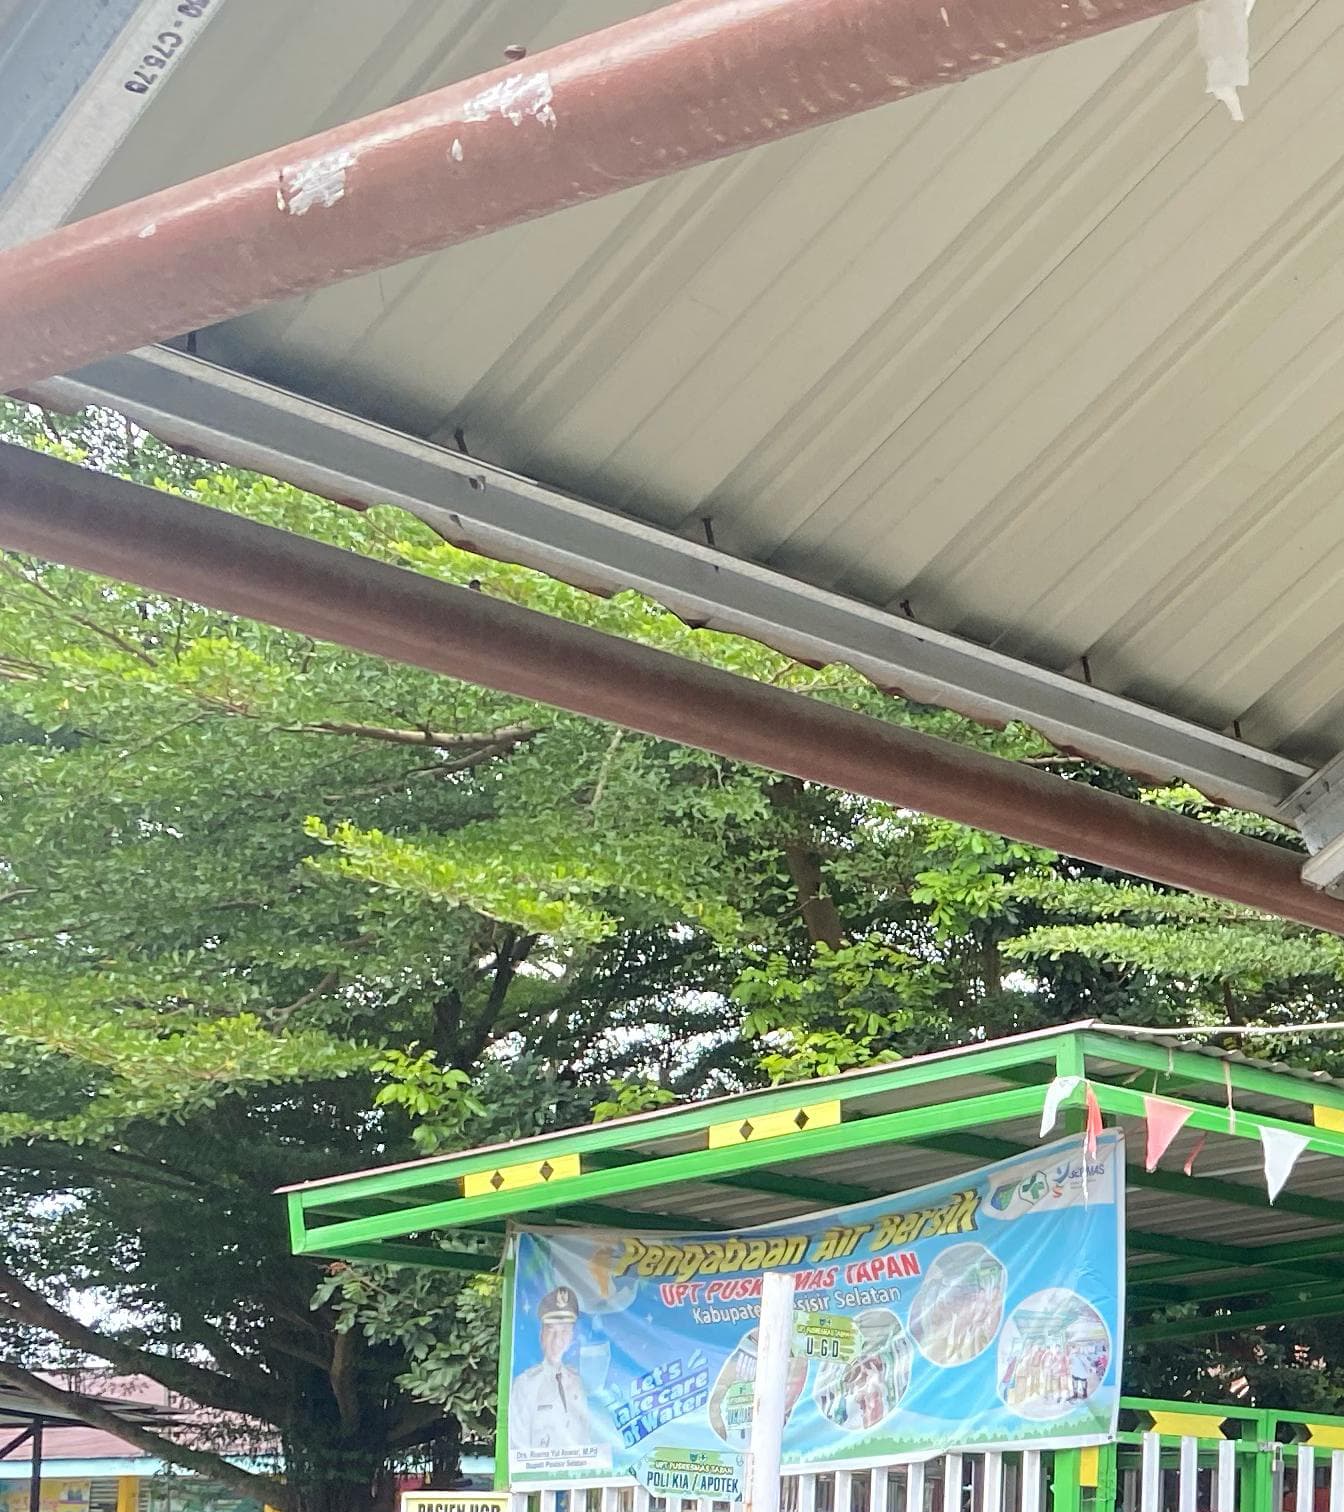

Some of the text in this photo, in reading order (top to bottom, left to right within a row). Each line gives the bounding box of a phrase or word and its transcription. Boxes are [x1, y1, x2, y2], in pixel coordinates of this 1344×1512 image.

[661, 1282, 704, 1308] UPT
[845, 1251, 921, 1286] TAPAN
[692, 1303, 762, 1325] Kabupate
[834, 1286, 901, 1309] Selatan
[630, 1359, 682, 1397] Let's
[647, 1471, 669, 1488] POLI
[672, 1473, 688, 1489] KIA
[701, 1475, 738, 1493] APOTEK
